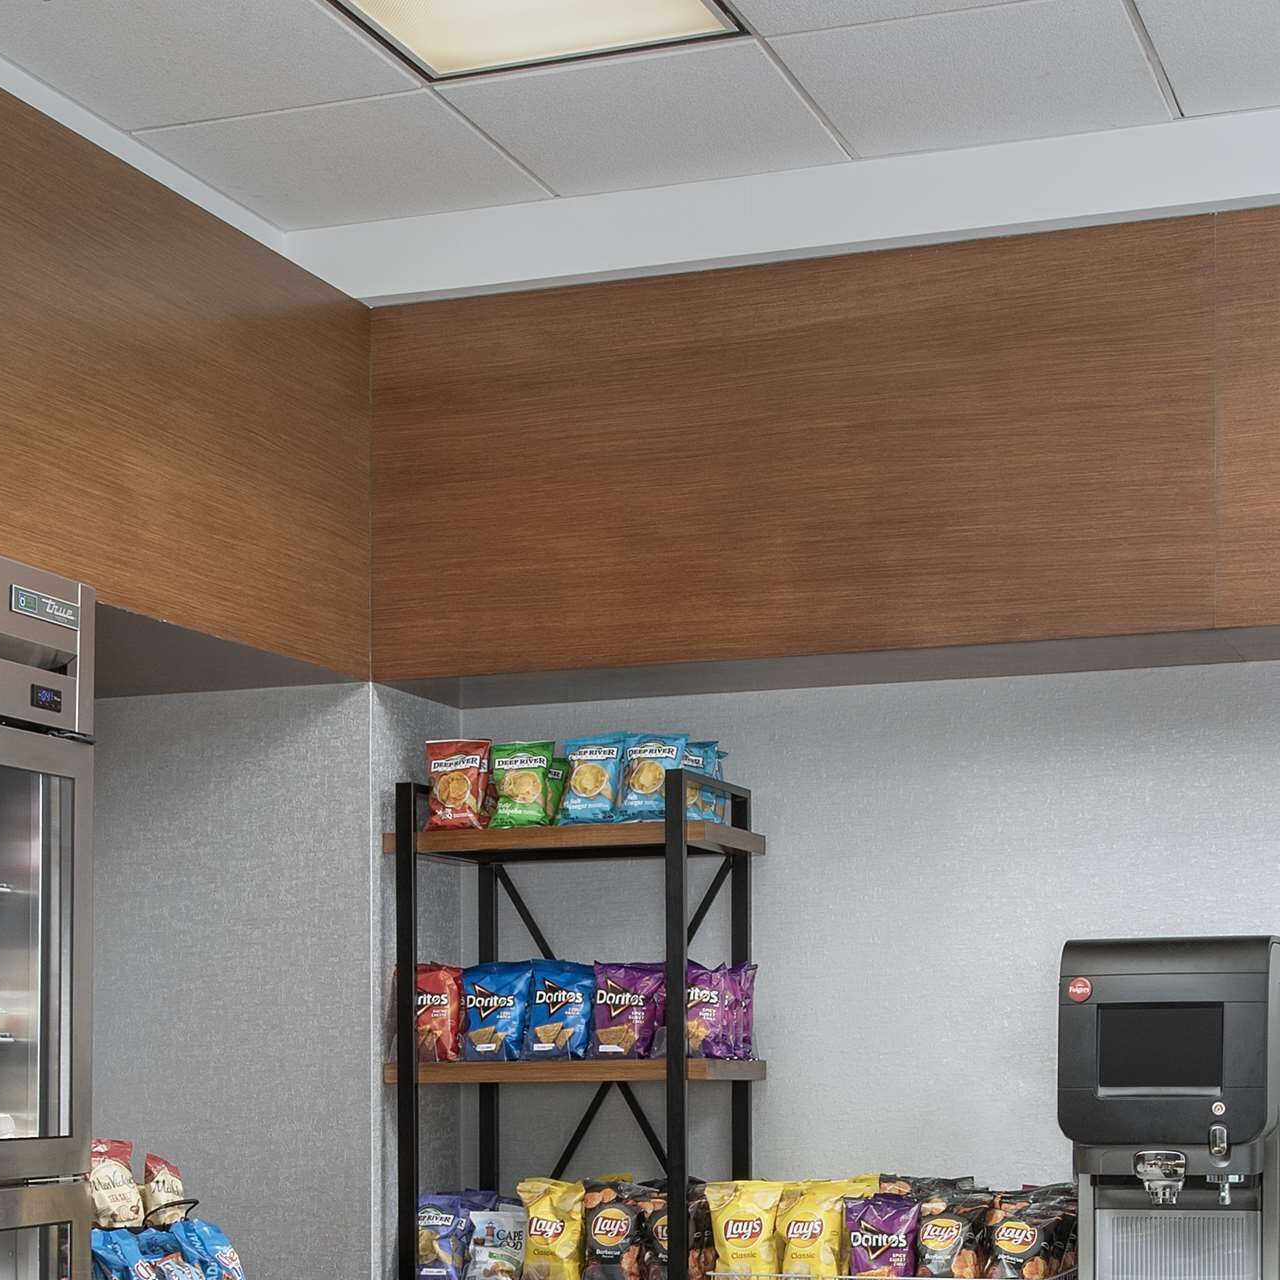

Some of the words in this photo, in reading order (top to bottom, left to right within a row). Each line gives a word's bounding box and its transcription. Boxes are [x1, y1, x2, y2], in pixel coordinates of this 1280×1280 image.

[590, 748, 615, 757] RIVER
[628, 749, 649, 757] DEEP
[650, 747, 674, 756] RIVER
[433, 760, 454, 770] DEEP
[455, 757, 478, 767] RIVER
[497, 759, 519, 767] DEEP
[520, 757, 546, 766] RIVER
[466, 994, 514, 1008] Doritos
[535, 990, 583, 1004] Doritos
[596, 989, 646, 1006] Doritos
[429, 1215, 451, 1226] RIVER
[529, 1216, 564, 1238] Lay's
[594, 1215, 628, 1237] Lay's
[724, 1217, 762, 1241] Lay's
[786, 1217, 822, 1242] Lay's
[922, 1221, 960, 1242] Lay's
[998, 1225, 1037, 1245] Lay's
[850, 1231, 907, 1248] Doritos
